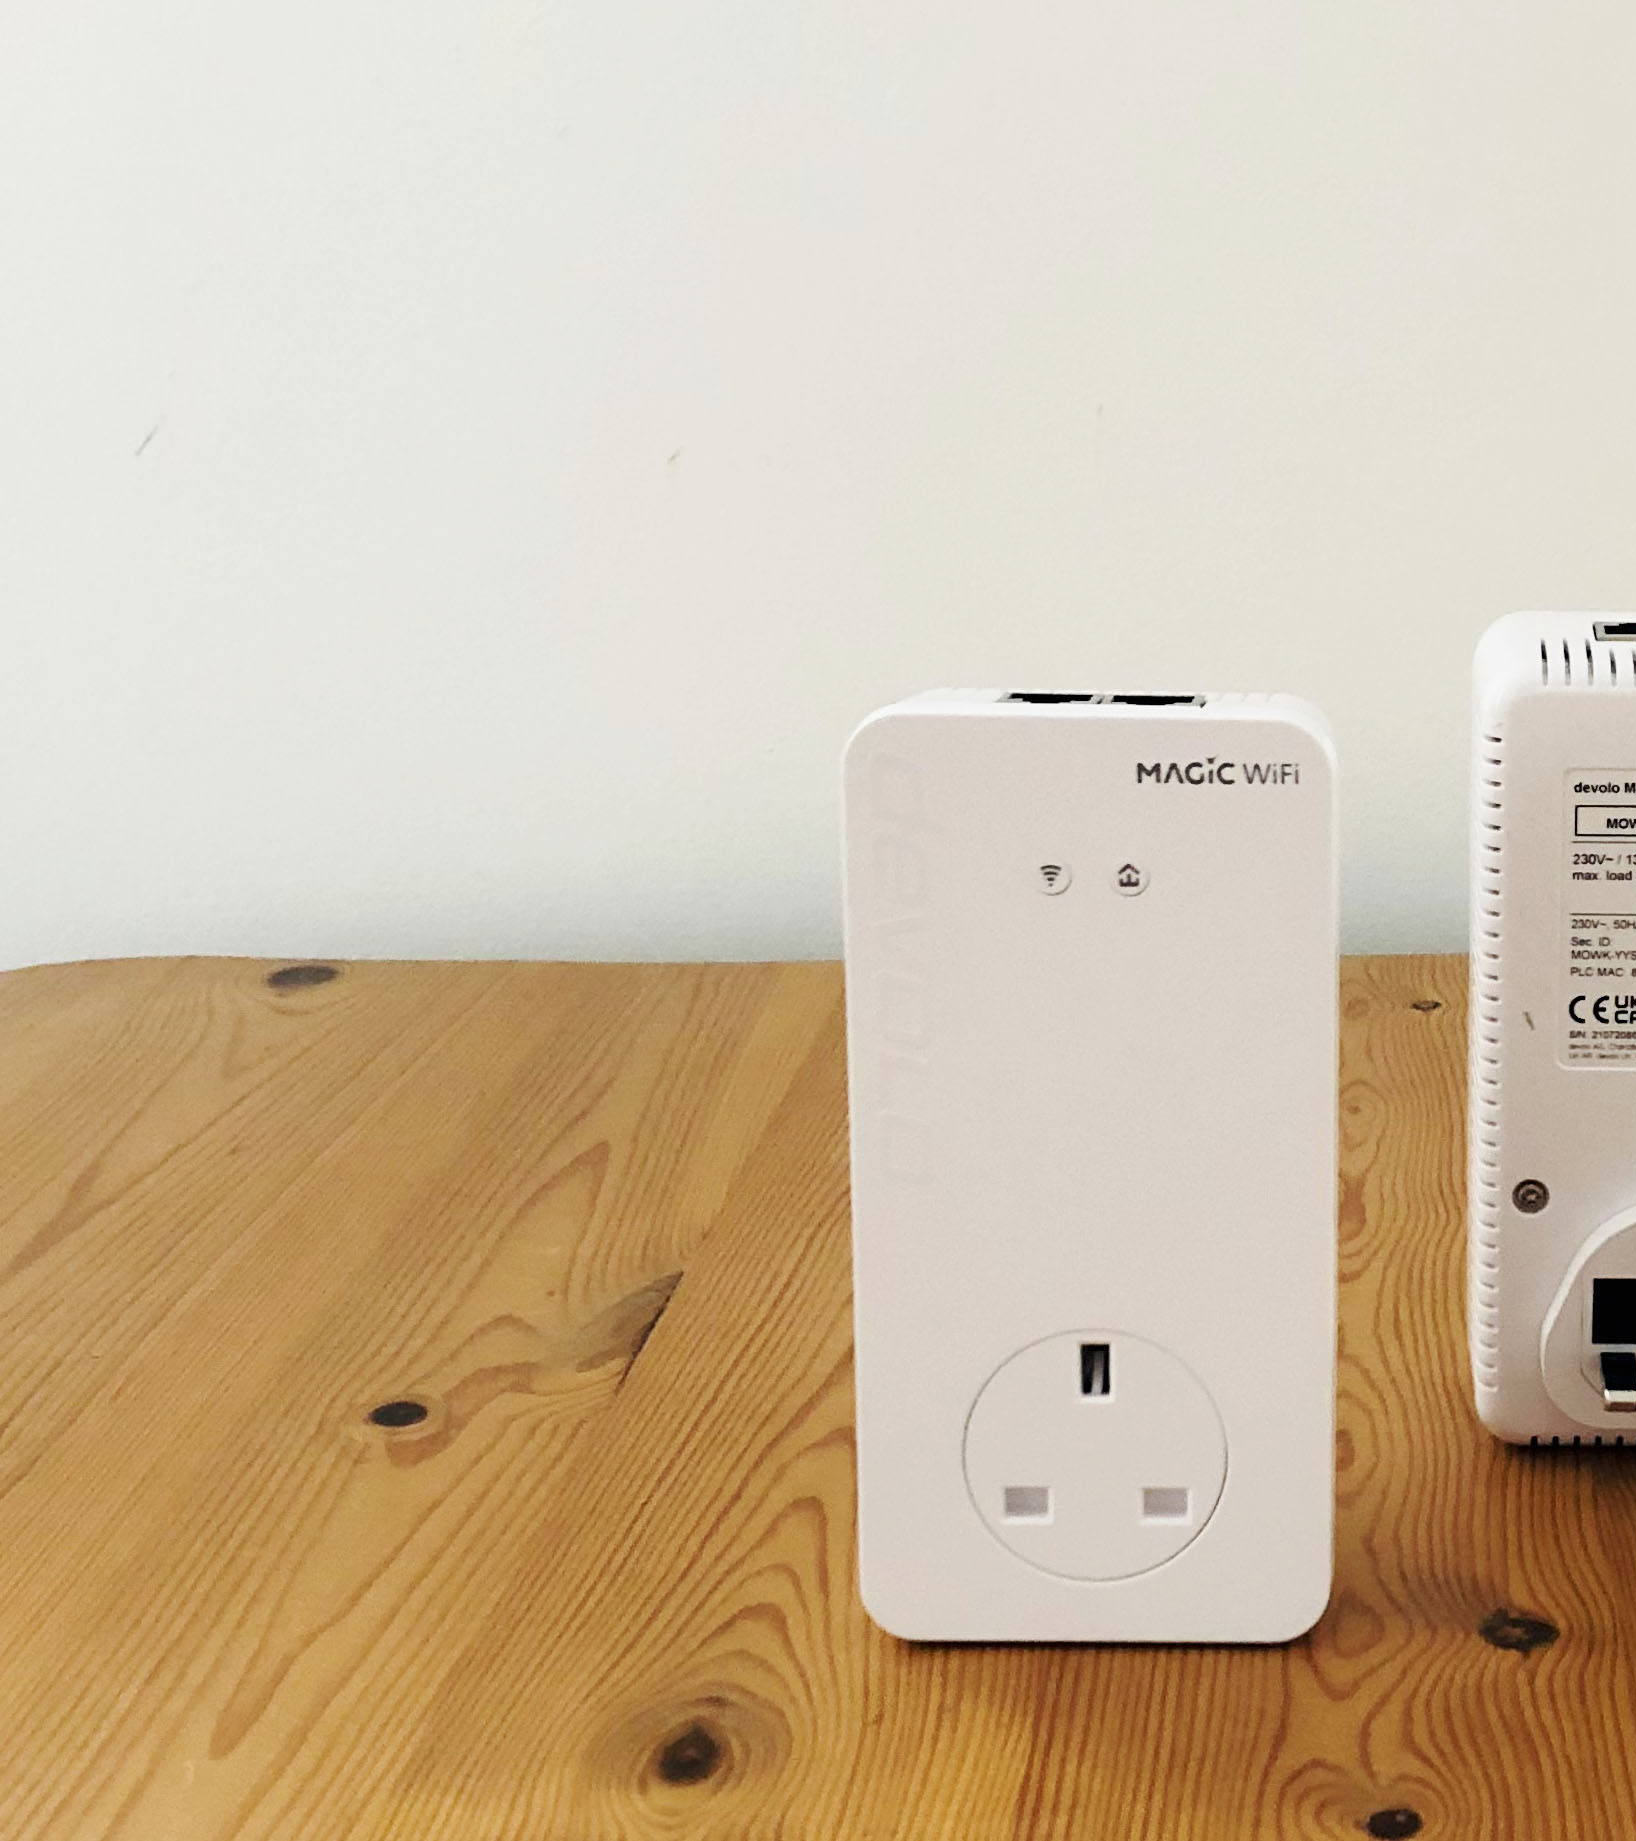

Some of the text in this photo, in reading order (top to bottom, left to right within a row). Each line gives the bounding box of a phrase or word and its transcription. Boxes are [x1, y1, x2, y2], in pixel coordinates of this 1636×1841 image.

[1243, 763, 1300, 784] WiFi
[1574, 782, 1620, 794] devolo
[1573, 854, 1614, 866] 230V~
[1606, 870, 1633, 882] load
[1570, 967, 1594, 977] PLC
